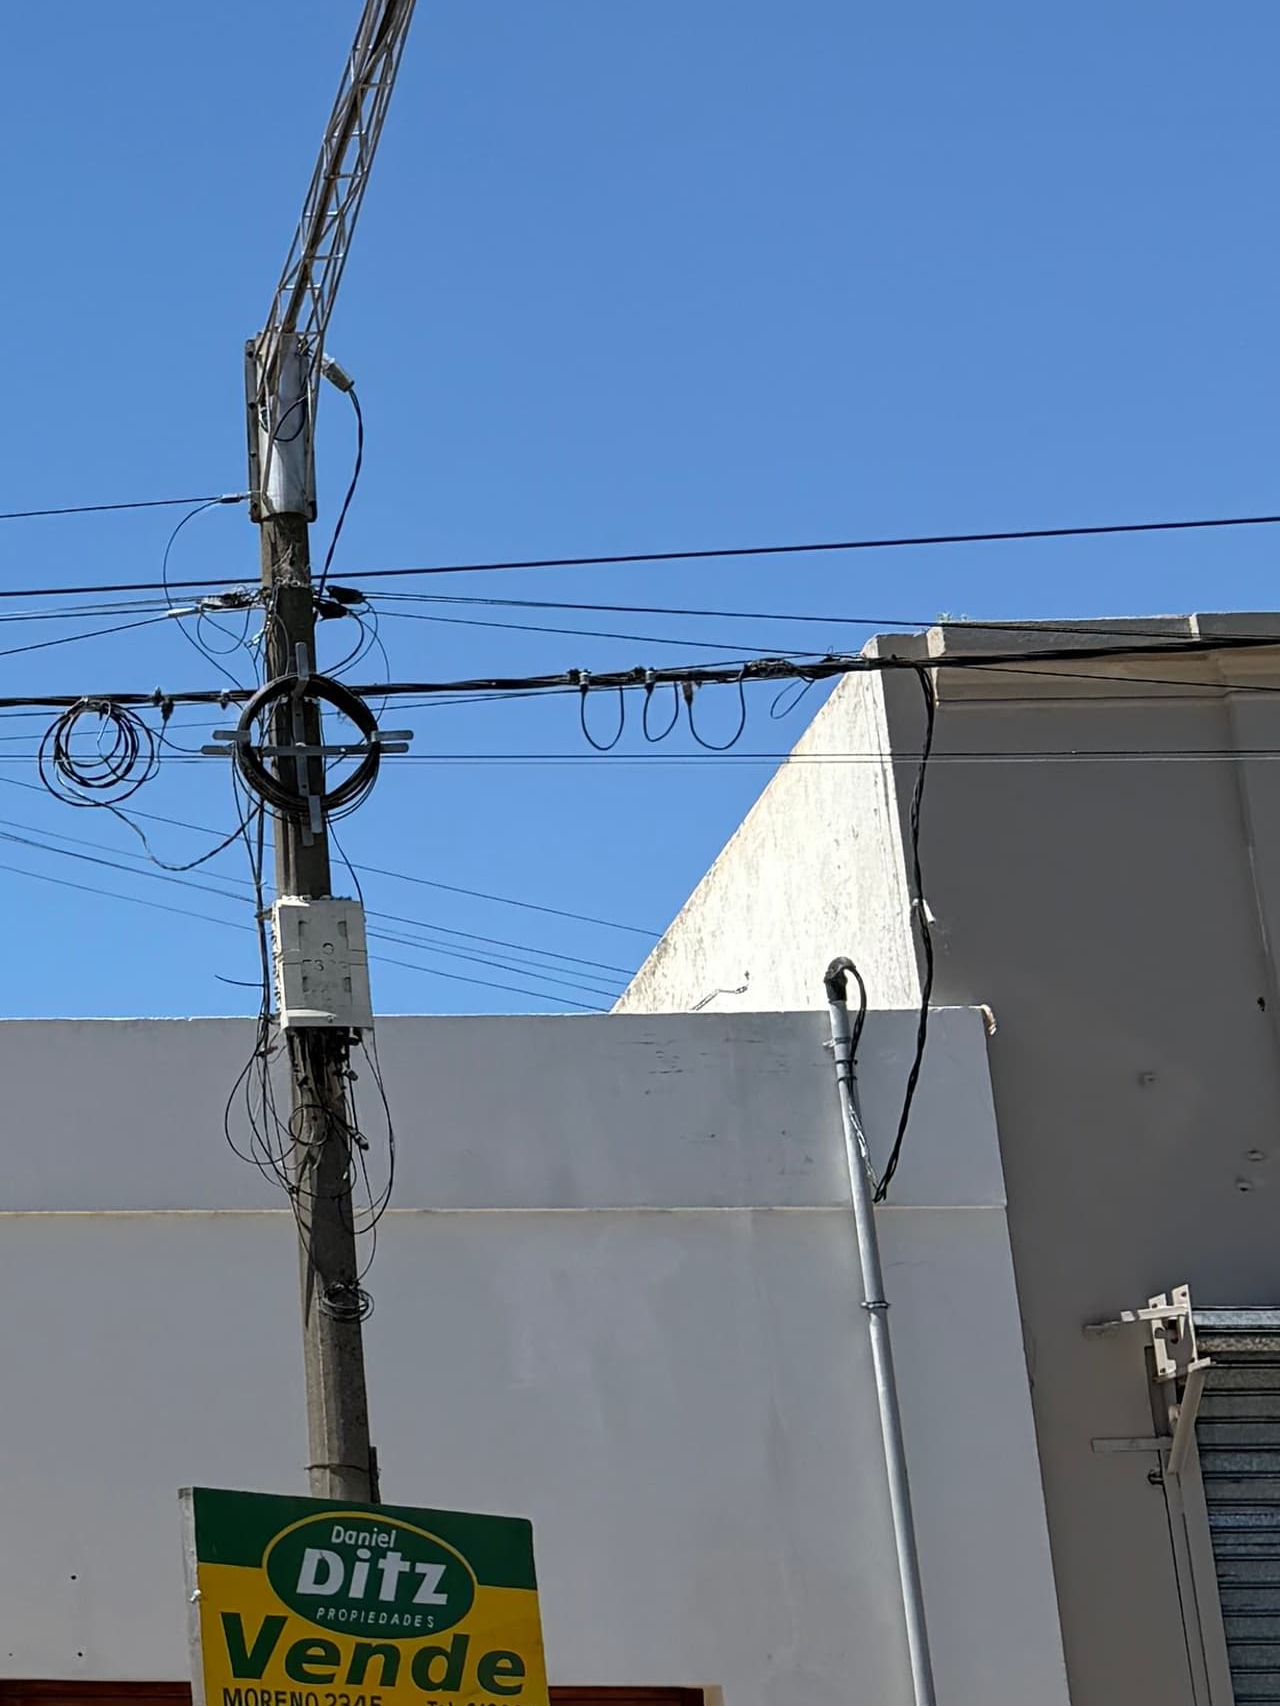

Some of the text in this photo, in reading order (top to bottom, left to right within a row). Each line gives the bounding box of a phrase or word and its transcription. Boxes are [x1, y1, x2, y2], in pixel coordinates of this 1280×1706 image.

[332, 1526, 397, 1548] Daniel
[296, 1548, 449, 1606] Ditz
[316, 1607, 435, 1629] PROPIEDADES
[220, 1612, 526, 1696] Vende
